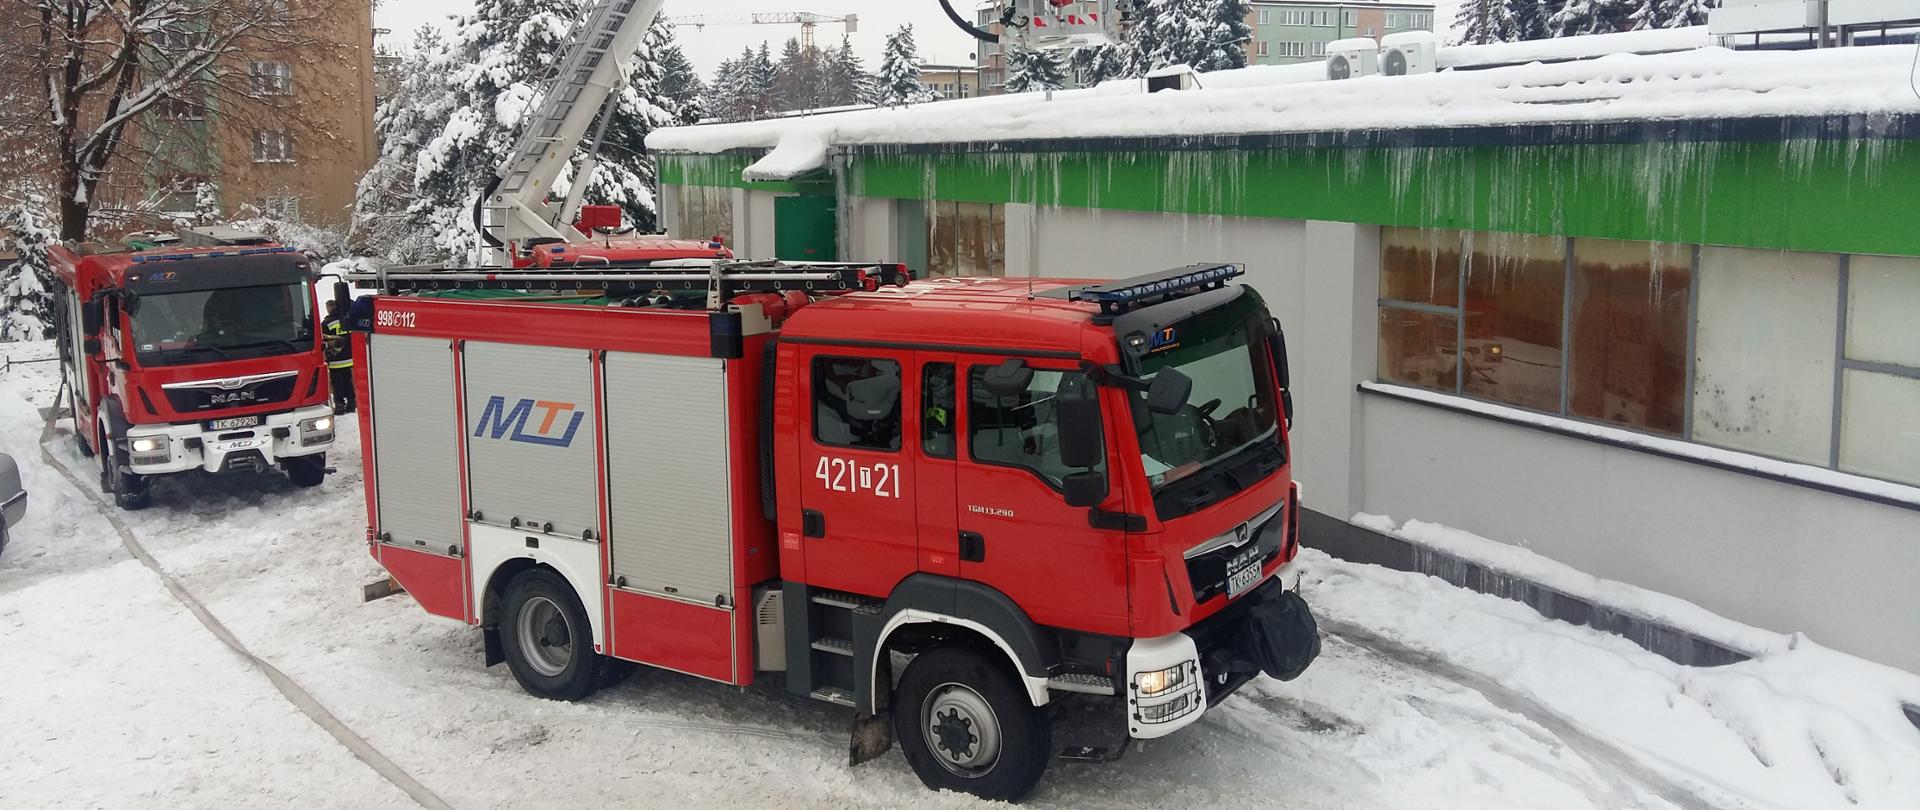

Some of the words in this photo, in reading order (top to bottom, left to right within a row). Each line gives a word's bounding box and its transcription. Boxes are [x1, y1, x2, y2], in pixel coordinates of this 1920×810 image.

[377, 311, 393, 326] 998
[401, 312, 415, 327] 112
[211, 391, 255, 403] MAN
[216, 420, 227, 428] TK
[230, 417, 256, 427] 6792N
[815, 456, 856, 493] 421
[874, 463, 899, 498] 21
[1226, 546, 1259, 577] MAN
